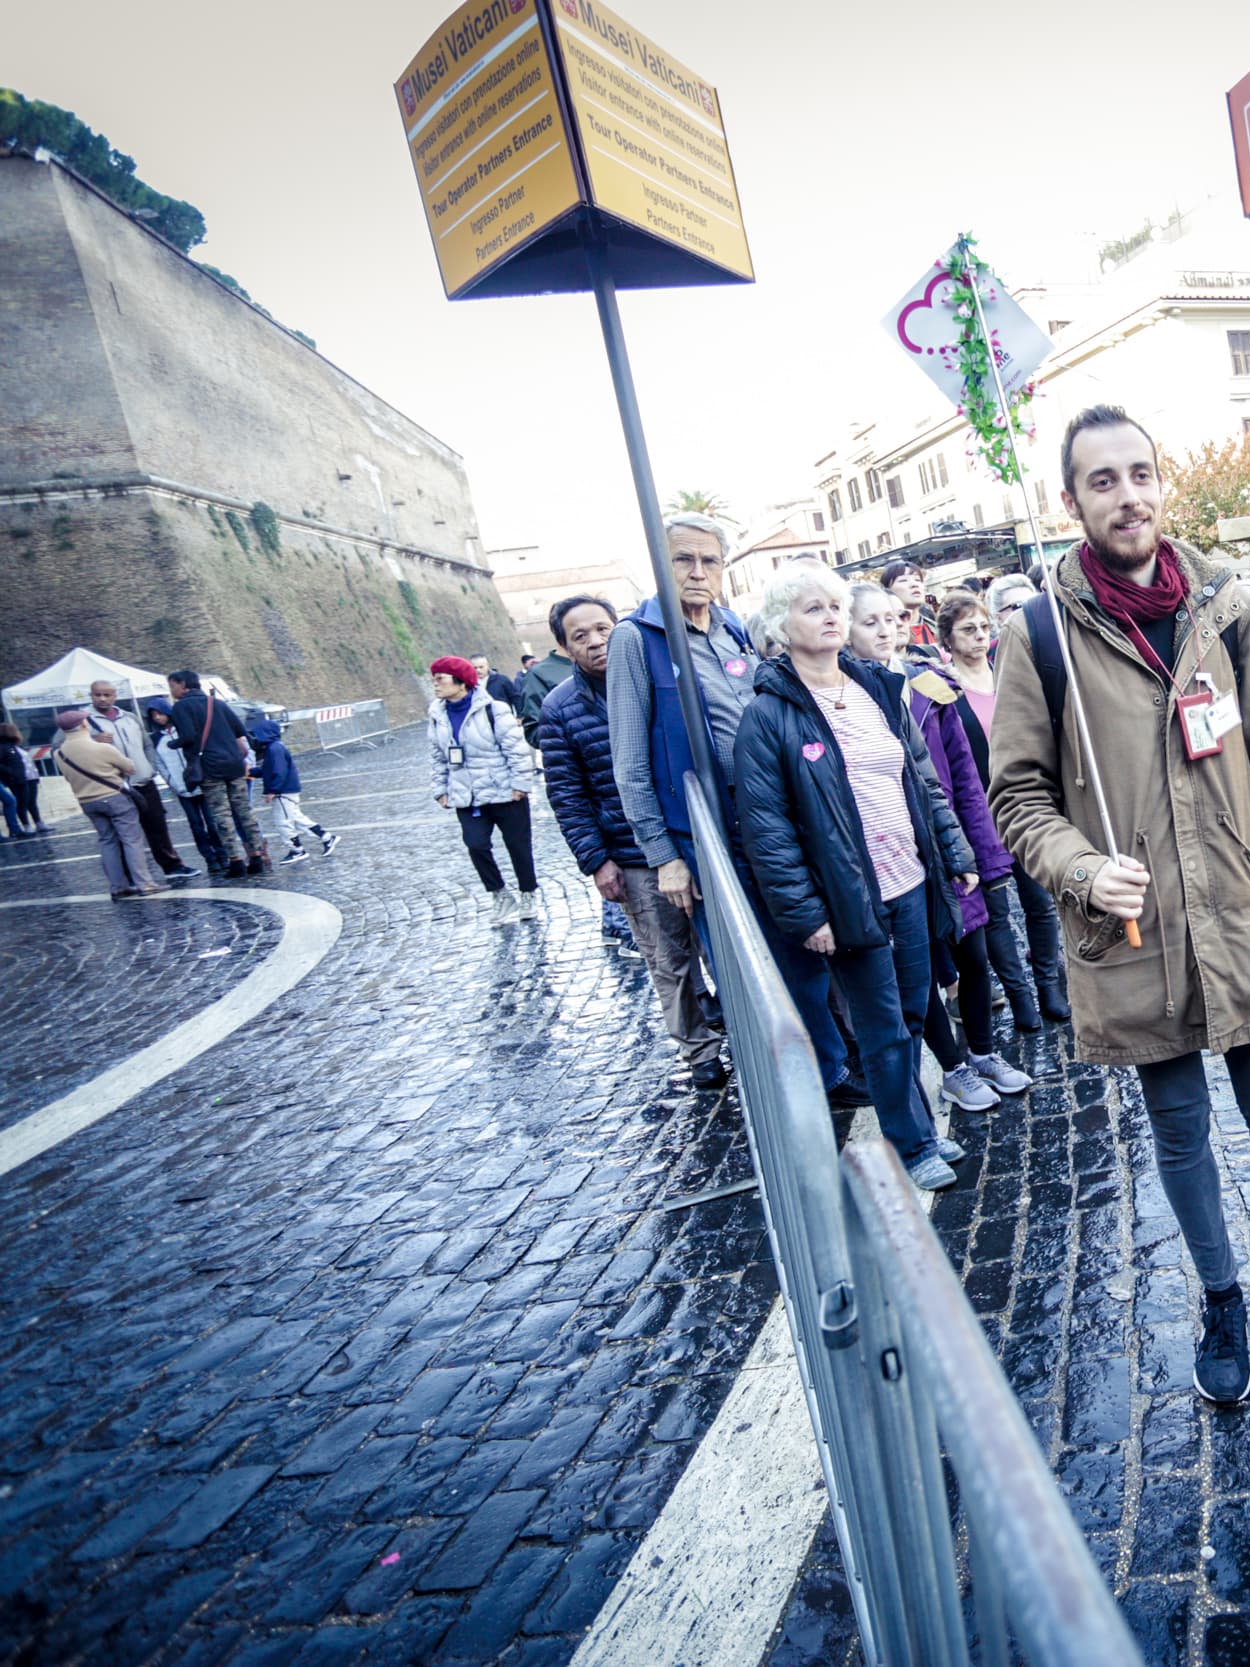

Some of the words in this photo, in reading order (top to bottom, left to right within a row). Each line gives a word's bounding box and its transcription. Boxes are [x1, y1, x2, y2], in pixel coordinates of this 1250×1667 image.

[411, 41, 449, 102] Musei
[445, 0, 510, 62] Vaticani
[461, 95, 472, 115] con
[472, 60, 516, 108] prenotazione
[516, 39, 540, 66] online
[579, 0, 634, 59] Musei
[635, 38, 700, 106] Vaticani
[476, 103, 498, 128] online
[498, 66, 542, 109] reservations
[432, 199, 448, 219] Tour
[447, 172, 478, 206] Operator
[477, 145, 513, 180] Partners
[512, 114, 553, 151] Entrance
[586, 112, 612, 140] Tour
[614, 130, 658, 167] Operator
[658, 156, 698, 190] Partners
[698, 180, 735, 212] Entrance
[470, 207, 503, 235] Ingresso
[498, 185, 525, 214] Partner
[475, 233, 502, 262] Partners
[502, 212, 536, 243] Entrance
[642, 183, 679, 214] Ingresso
[679, 202, 708, 228] Partner
[647, 209, 681, 238] Partners
[682, 225, 716, 254] Entrance
